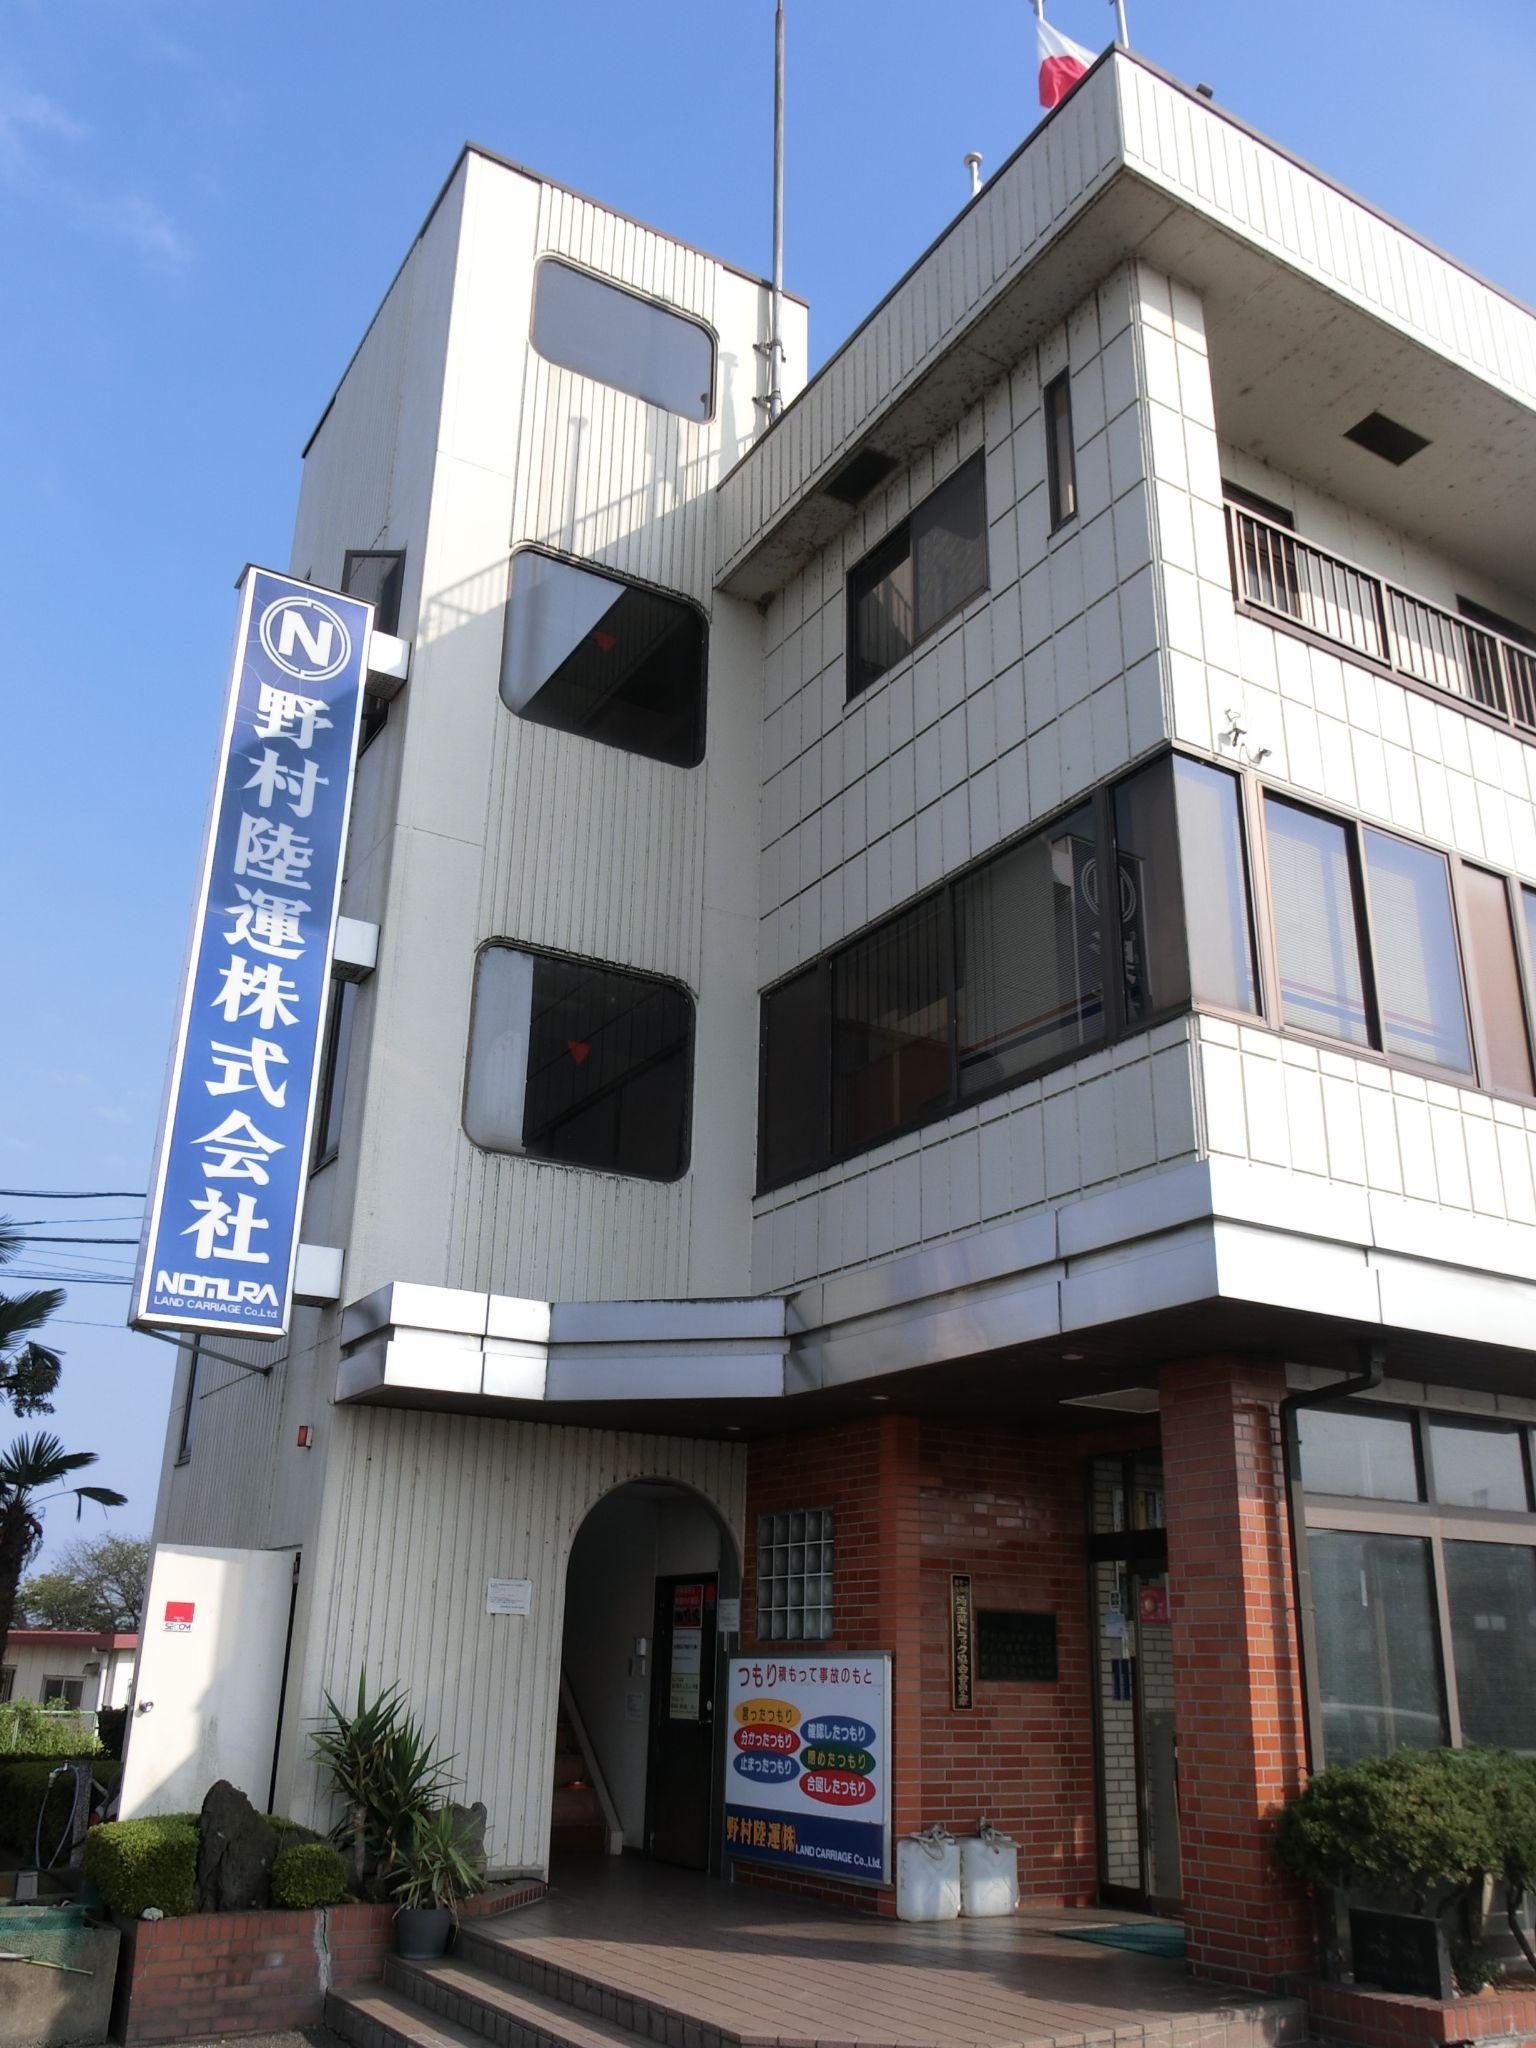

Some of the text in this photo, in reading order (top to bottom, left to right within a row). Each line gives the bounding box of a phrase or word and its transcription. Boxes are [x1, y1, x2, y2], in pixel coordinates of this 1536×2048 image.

[180, 682, 334, 1266] 野村陸運株式会社
[155, 1270, 279, 1307] NOMURA
[154, 1295, 184, 1308] LAND
[187, 1300, 242, 1315] CARRIAGE
[165, 1622, 191, 1631] SECOM
[742, 1706, 792, 1723] 言ったつもり
[741, 1730, 792, 1749] 分かったつもり
[807, 1723, 866, 1742] 確認したつもり
[740, 1755, 792, 1775] 止まったつもり
[807, 1776, 866, 1797] 合図したつもり
[795, 1844, 815, 1857] LAND
[816, 1847, 853, 1863] CARRIAGE
